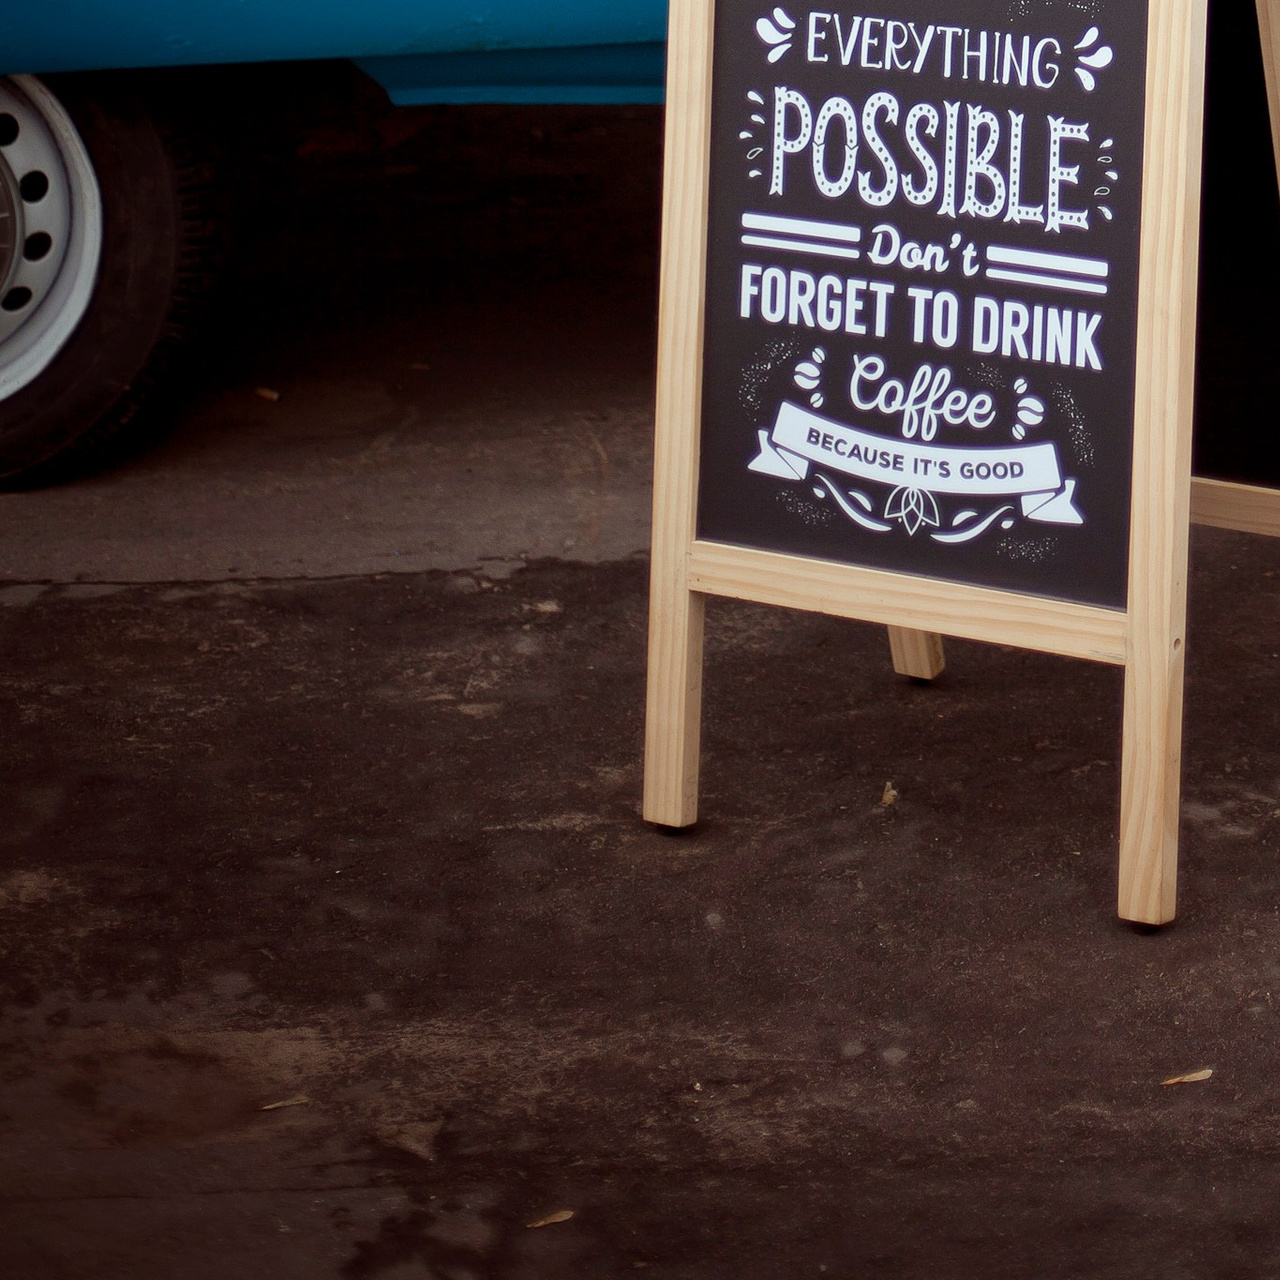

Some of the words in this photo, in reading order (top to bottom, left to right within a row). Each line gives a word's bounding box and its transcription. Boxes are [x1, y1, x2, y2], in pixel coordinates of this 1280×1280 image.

[807, 13, 1061, 87] EVERYTHING
[769, 86, 1090, 233] POSSIBLE
[867, 224, 980, 277] Don't
[740, 264, 896, 338] FORGET
[907, 285, 959, 349] TO
[972, 296, 1103, 371] DRINK
[848, 353, 996, 442] Coffee
[806, 427, 905, 473] BECAUSE
[913, 455, 951, 478] IT'S
[959, 460, 1025, 481] GOOD
